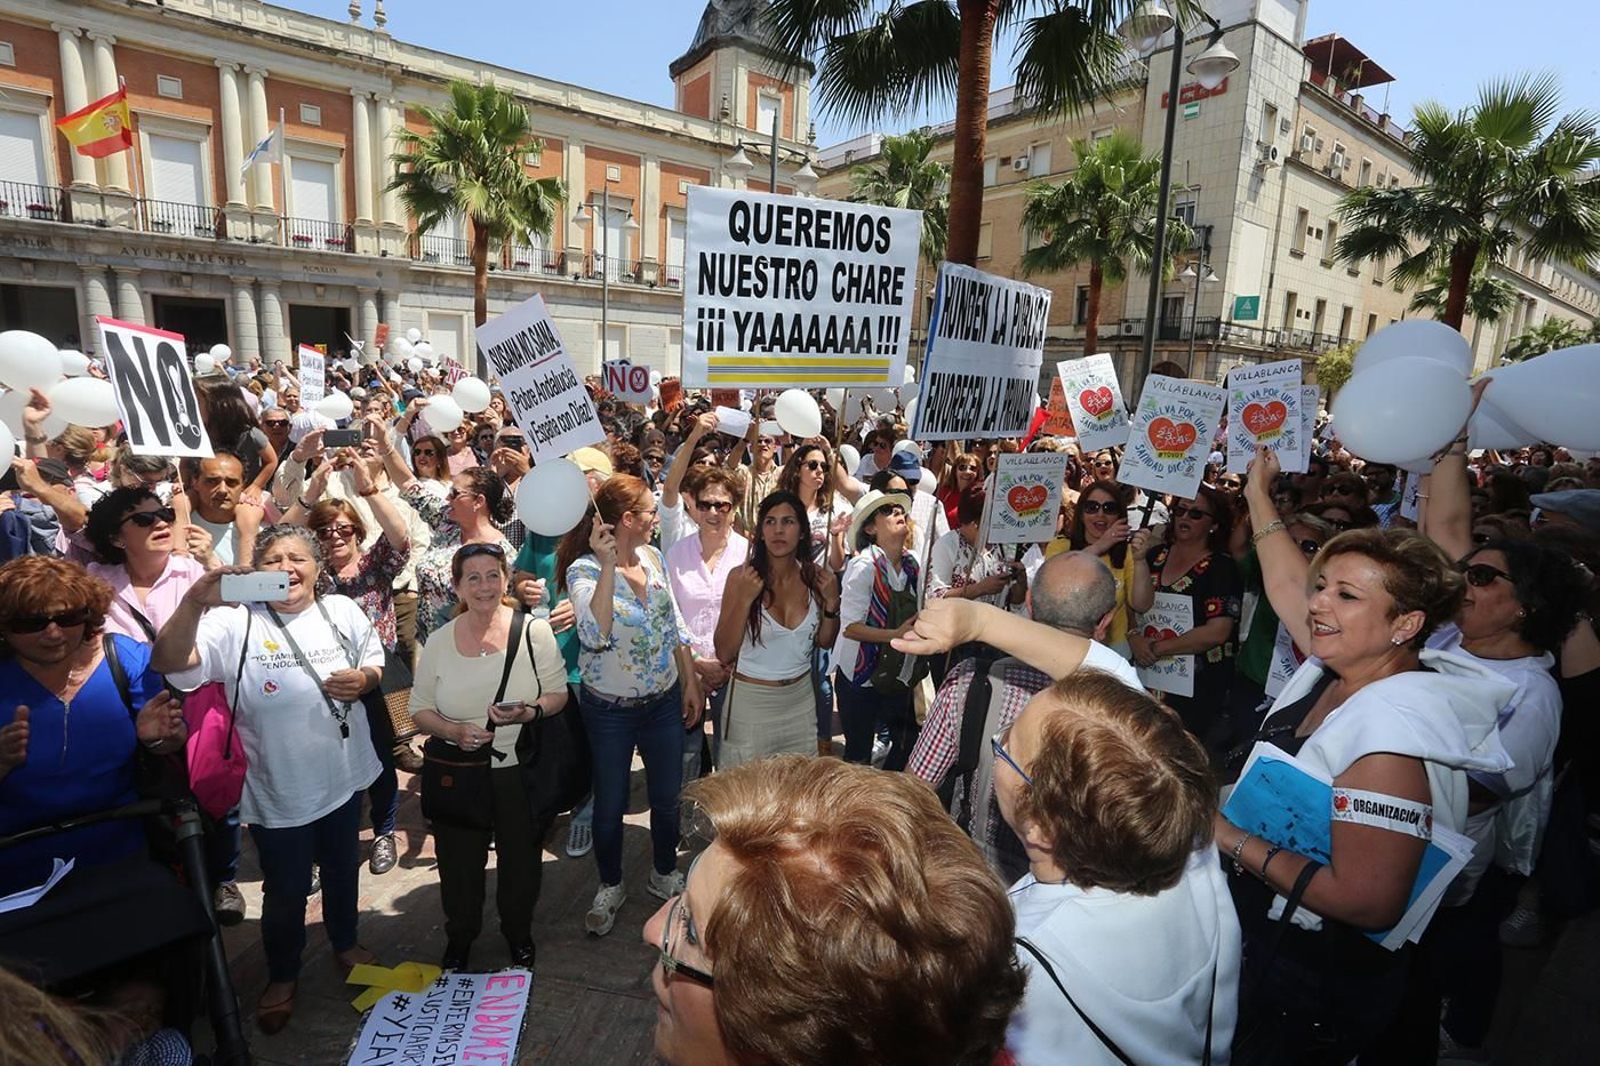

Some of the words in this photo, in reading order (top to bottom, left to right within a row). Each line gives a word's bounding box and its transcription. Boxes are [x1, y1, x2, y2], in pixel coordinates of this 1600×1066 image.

[729, 200, 891, 254] QUEREMOS
[119, 246, 248, 266] AYUNTAMIENTO
[698, 252, 818, 301] NUESTRO
[832, 261, 906, 306] CHARE
[938, 273, 993, 343] HUNDEN
[990, 286, 1009, 346] LA
[1009, 291, 1049, 350] PUBLICA
[488, 337, 526, 377] SUSANA
[515, 330, 537, 363] NO
[1234, 364, 1302, 381] VILLABLANCA
[533, 364, 578, 403] Andalucía
[609, 365, 649, 393] NO
[558, 411, 576, 432] con
[921, 372, 987, 433] FAVORECEN
[982, 376, 1003, 432] LA
[998, 378, 1034, 432] PRIVADA
[527, 430, 539, 452] y
[530, 414, 560, 446] España
[1005, 456, 1064, 466] VILLABLANCA
[1353, 798, 1421, 826] ORGANIZACIÓN
[361, 994, 413, 1066] #YEA
[401, 976, 450, 1066] #JUSTICIAPOR
[462, 974, 526, 1066] ENDOME
